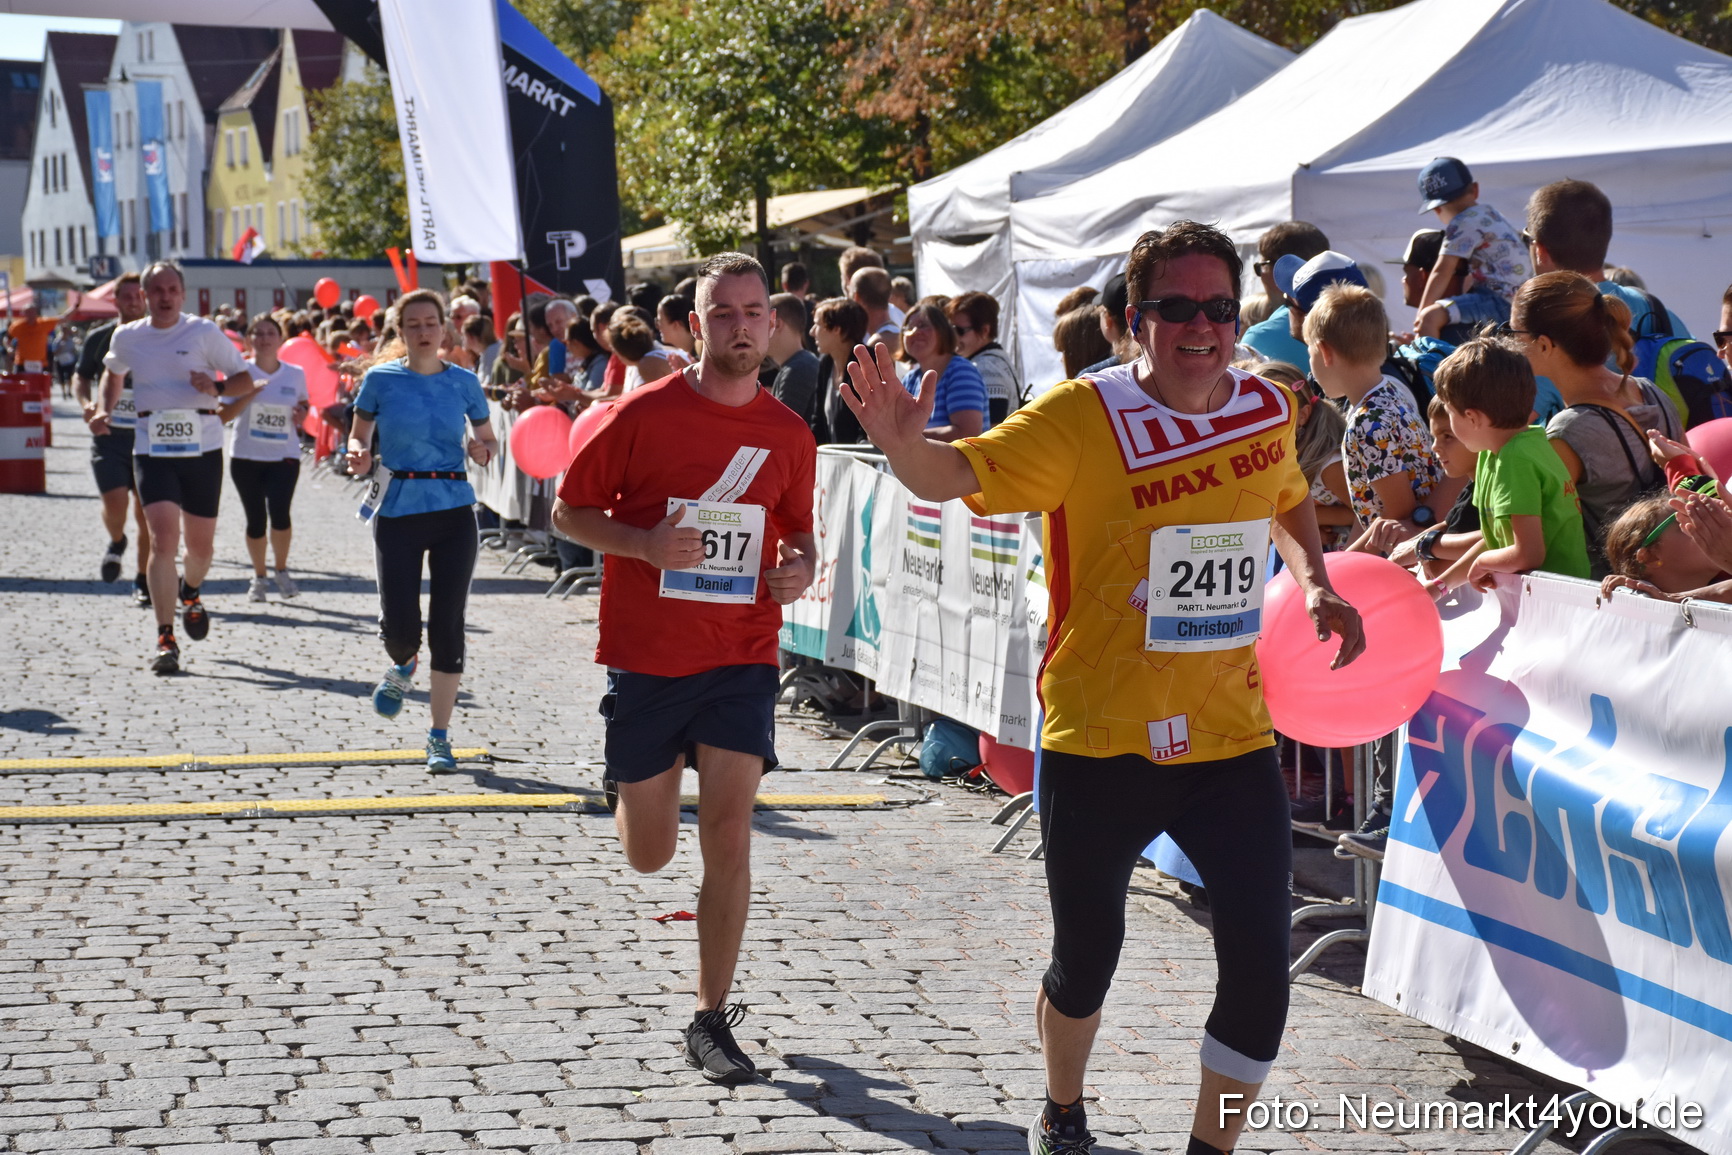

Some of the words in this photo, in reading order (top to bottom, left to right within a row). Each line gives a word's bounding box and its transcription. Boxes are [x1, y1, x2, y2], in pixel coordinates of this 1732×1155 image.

[256, 413, 286, 428] 2428
[156, 421, 194, 437] 2593
[1131, 463, 1224, 510] MAX
[1229, 438, 1286, 480] BÖGL
[698, 509, 742, 523] BOCK
[701, 529, 752, 561] 617
[1191, 533, 1244, 549] BOCK
[709, 564, 737, 572] Neumarkt
[695, 576, 733, 592] Daniel
[1169, 556, 1255, 598] 2419
[1177, 603, 1205, 612] PARTL
[1206, 601, 1240, 611] Neumarkt
[1177, 617, 1244, 637] Christoph
